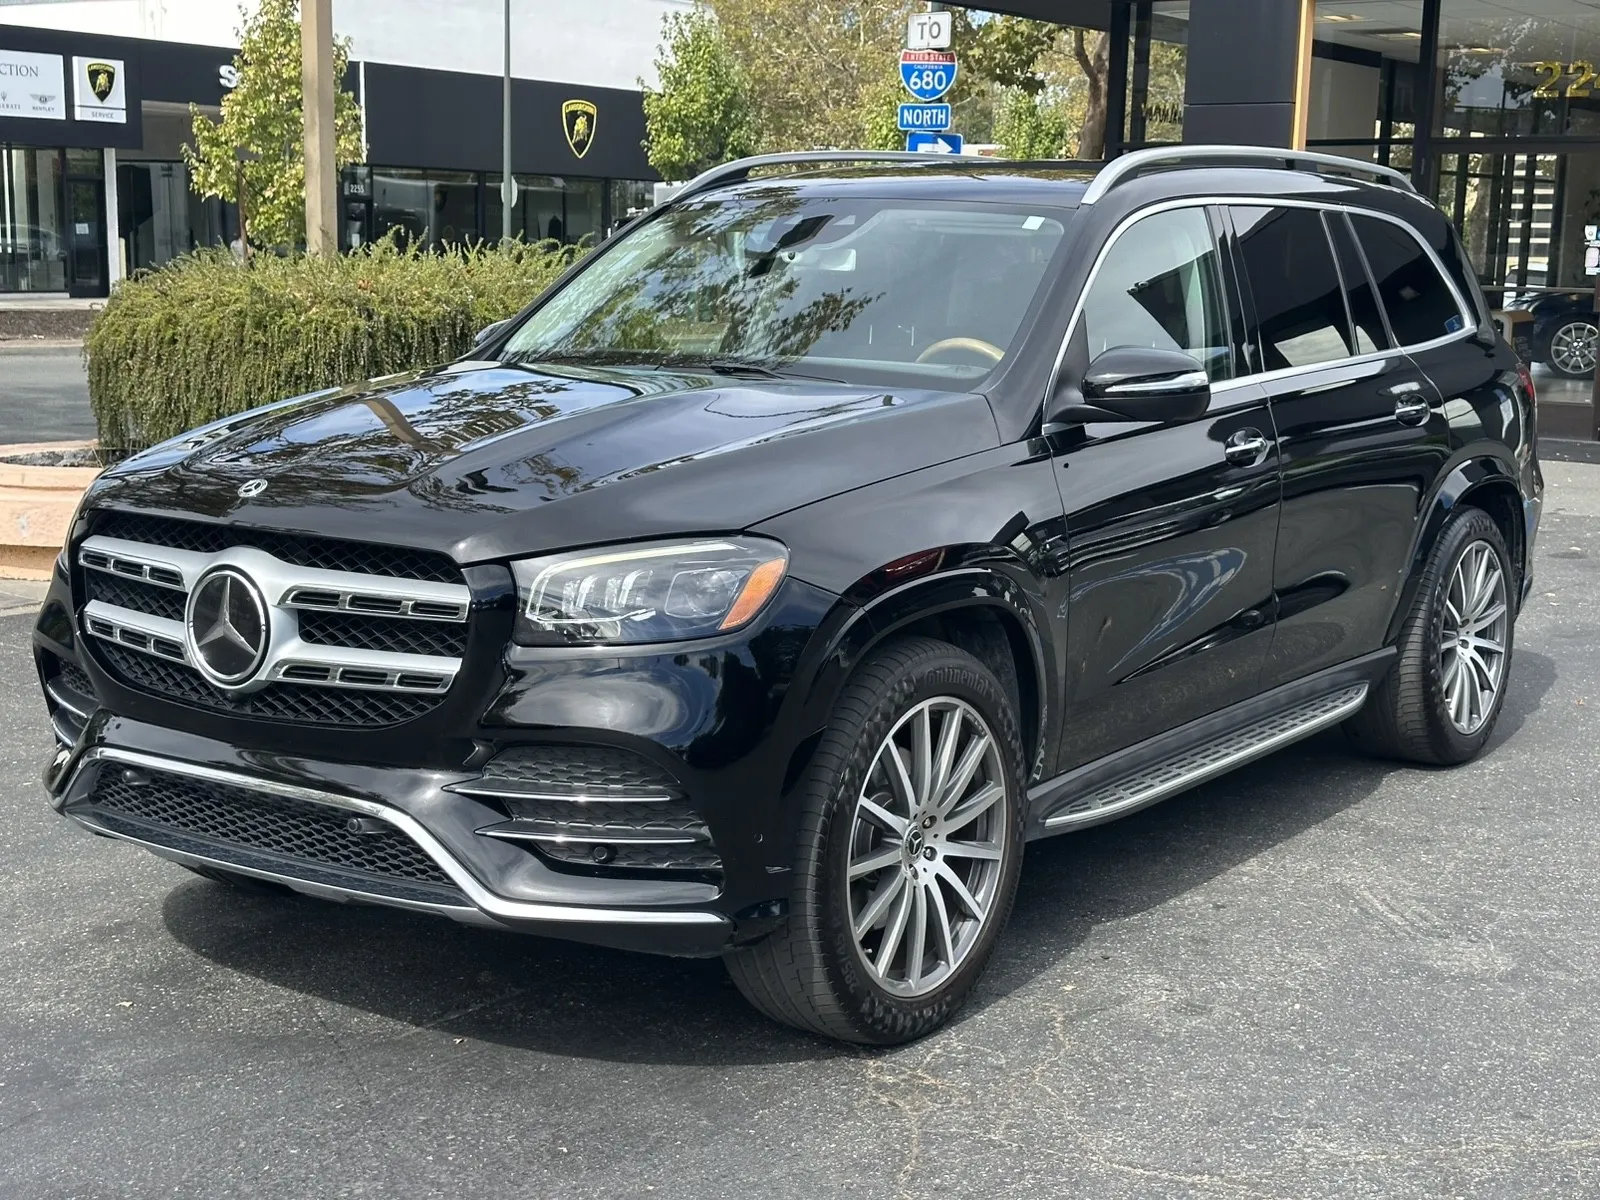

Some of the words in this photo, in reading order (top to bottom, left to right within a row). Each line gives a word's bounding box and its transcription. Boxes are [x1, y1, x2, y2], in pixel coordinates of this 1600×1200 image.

[917, 21, 941, 40] TO
[906, 52, 951, 62] INTERSTATE
[0, 63, 39, 77] CTION
[909, 71, 947, 90] 680
[1532, 60, 1600, 98] 22
[91, 111, 115, 119] SERVICE
[903, 108, 946, 125] NORTH
